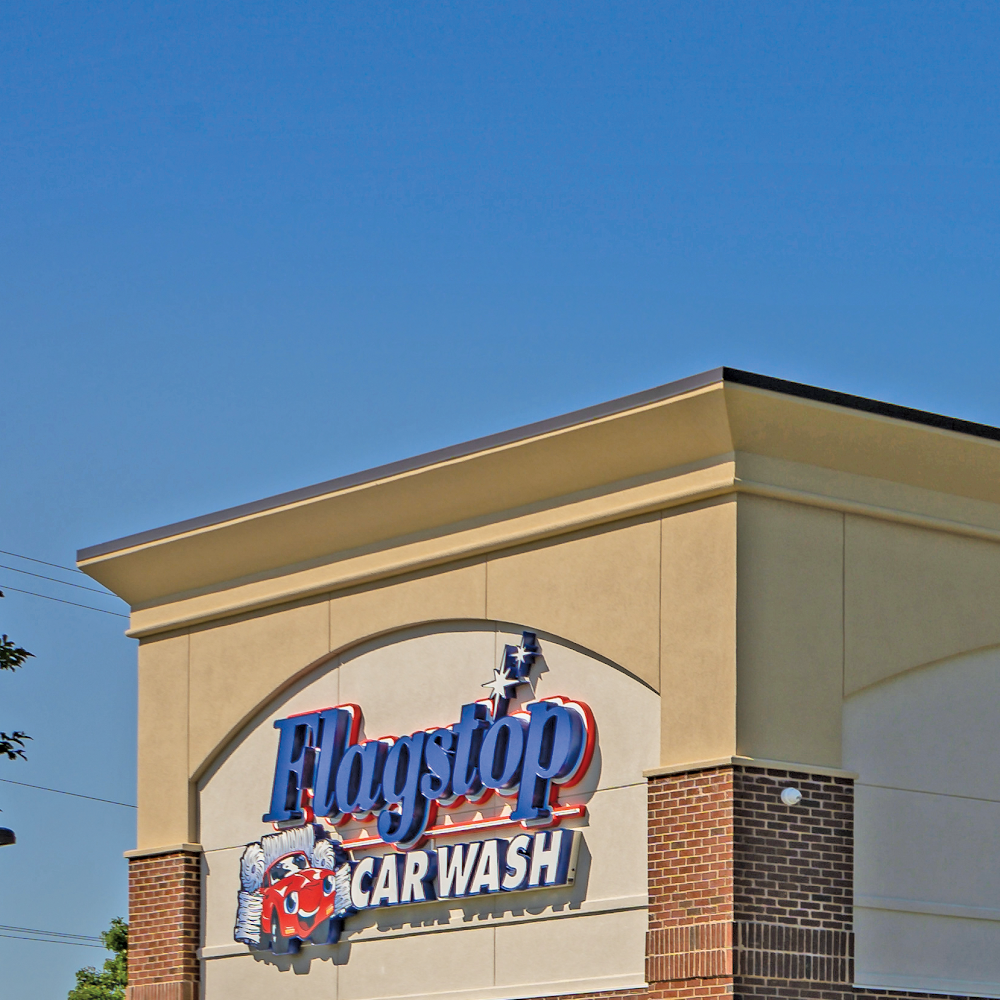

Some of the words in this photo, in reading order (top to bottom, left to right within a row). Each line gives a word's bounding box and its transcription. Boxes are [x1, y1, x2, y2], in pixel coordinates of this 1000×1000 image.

[262, 697, 590, 845] Flagstop
[351, 850, 430, 909] CAR
[437, 828, 566, 898] WASH
